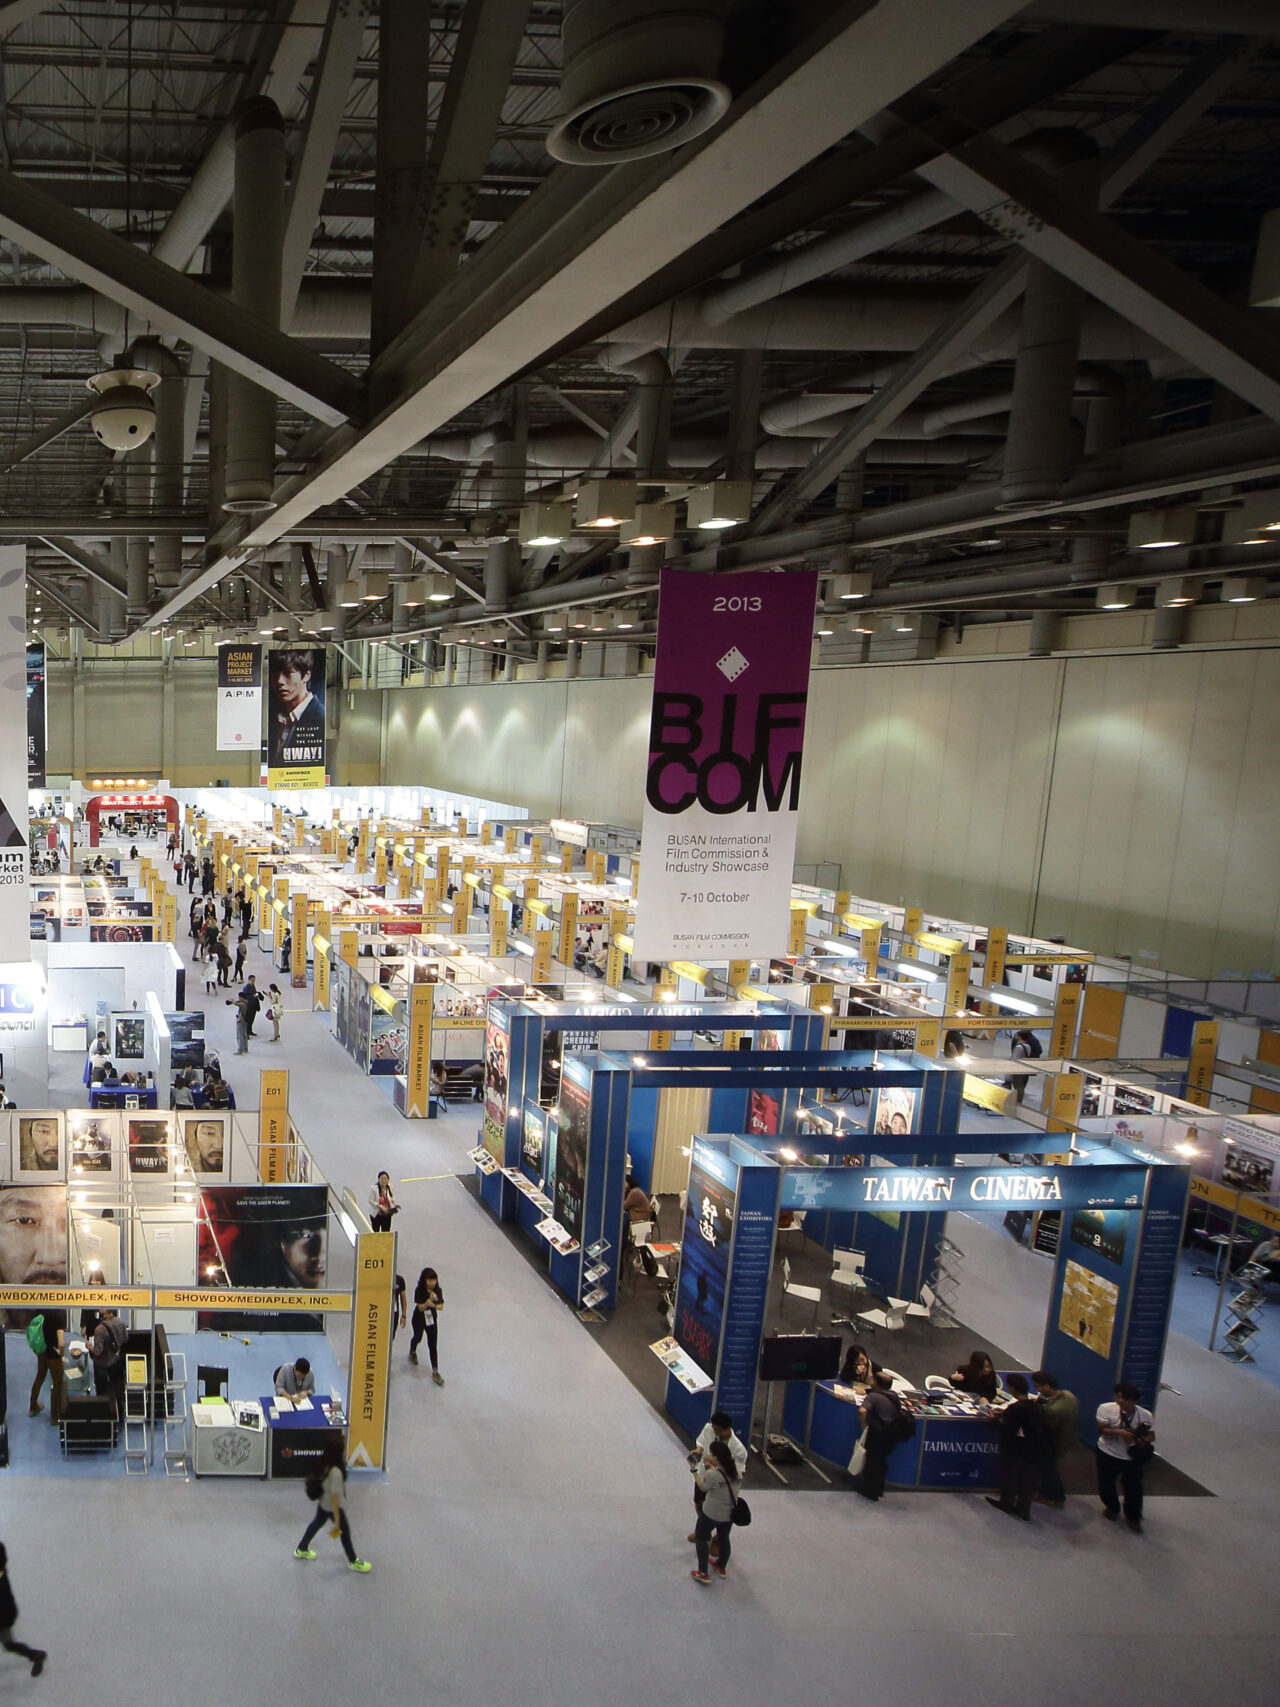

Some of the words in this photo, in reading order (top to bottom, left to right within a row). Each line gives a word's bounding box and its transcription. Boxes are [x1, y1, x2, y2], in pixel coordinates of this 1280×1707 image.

[712, 597, 762, 612] 2013
[228, 652, 253, 660] ASIAN
[649, 692, 807, 753] BIF
[283, 746, 322, 760] HWAYI
[646, 751, 802, 814] COM
[667, 835, 706, 845] BUSAN
[710, 834, 771, 845] International
[666, 848, 689, 859] Film
[691, 848, 759, 859] Commission
[762, 847, 769, 858] &
[665, 862, 708, 874] Industry
[712, 861, 769, 872] Showcase
[0, 875, 24, 885] 2013
[680, 892, 703, 903] 7-10
[707, 892, 750, 903] October
[863, 1177, 955, 1201] TAIWAN
[970, 1176, 1062, 1200] CINEMA
[364, 1259, 384, 1268] E01
[110, 1292, 133, 1301] INC.
[174, 1293, 306, 1305] SHOWBOX/MEDIAPLEX,
[309, 1296, 332, 1305] INC.
[368, 1304, 378, 1339] ASIAN
[366, 1343, 376, 1368] FILM
[363, 1373, 375, 1421] MARKET
[924, 1441, 963, 1452] TAIWAN
